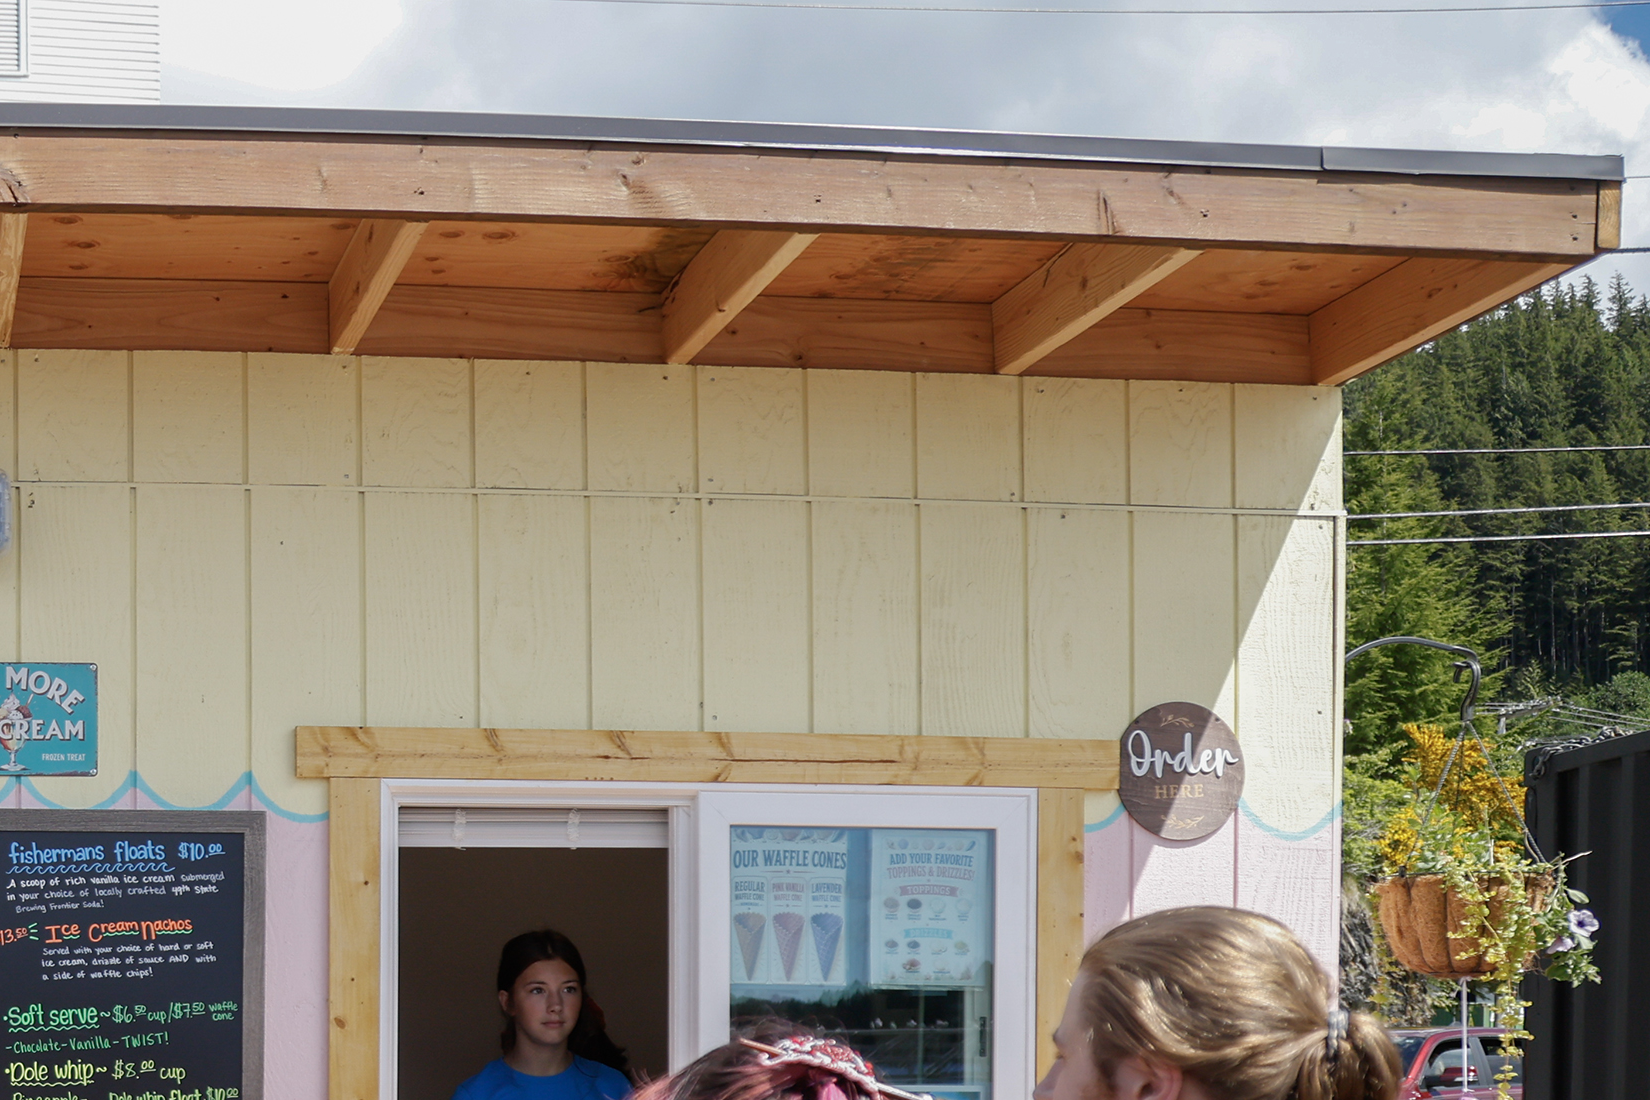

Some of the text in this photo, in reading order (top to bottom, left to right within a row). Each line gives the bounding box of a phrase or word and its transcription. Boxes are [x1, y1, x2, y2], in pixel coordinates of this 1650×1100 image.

[5, 666, 86, 715] MORE
[1128, 730, 1239, 778] Order
[1155, 784, 1204, 798] HERE
[9, 841, 226, 865] fishermans floats $10.00
[733, 850, 847, 870] OUR WAFFLE CONES
[890, 853, 974, 867] ADD YOUR FAVORITE
[7, 879, 16, 889] A
[20, 877, 46, 889] scoop
[50, 875, 61, 887] of
[65, 875, 86, 886] rich
[90, 873, 120, 884] vanilla
[124, 873, 139, 883] ice
[143, 873, 175, 883] cream
[887, 866, 975, 881] TOPPINGS & DRIZZLES!
[734, 881, 765, 892] REGULAR
[812, 883, 842, 894] LAVENDER
[907, 886, 950, 894] TOPPINGS
[45, 923, 81, 943] Ice
[89, 920, 139, 943] Cream
[8, 1003, 98, 1025] Soft serve
[11, 1059, 186, 1085] Dole whip $8.00 cup
